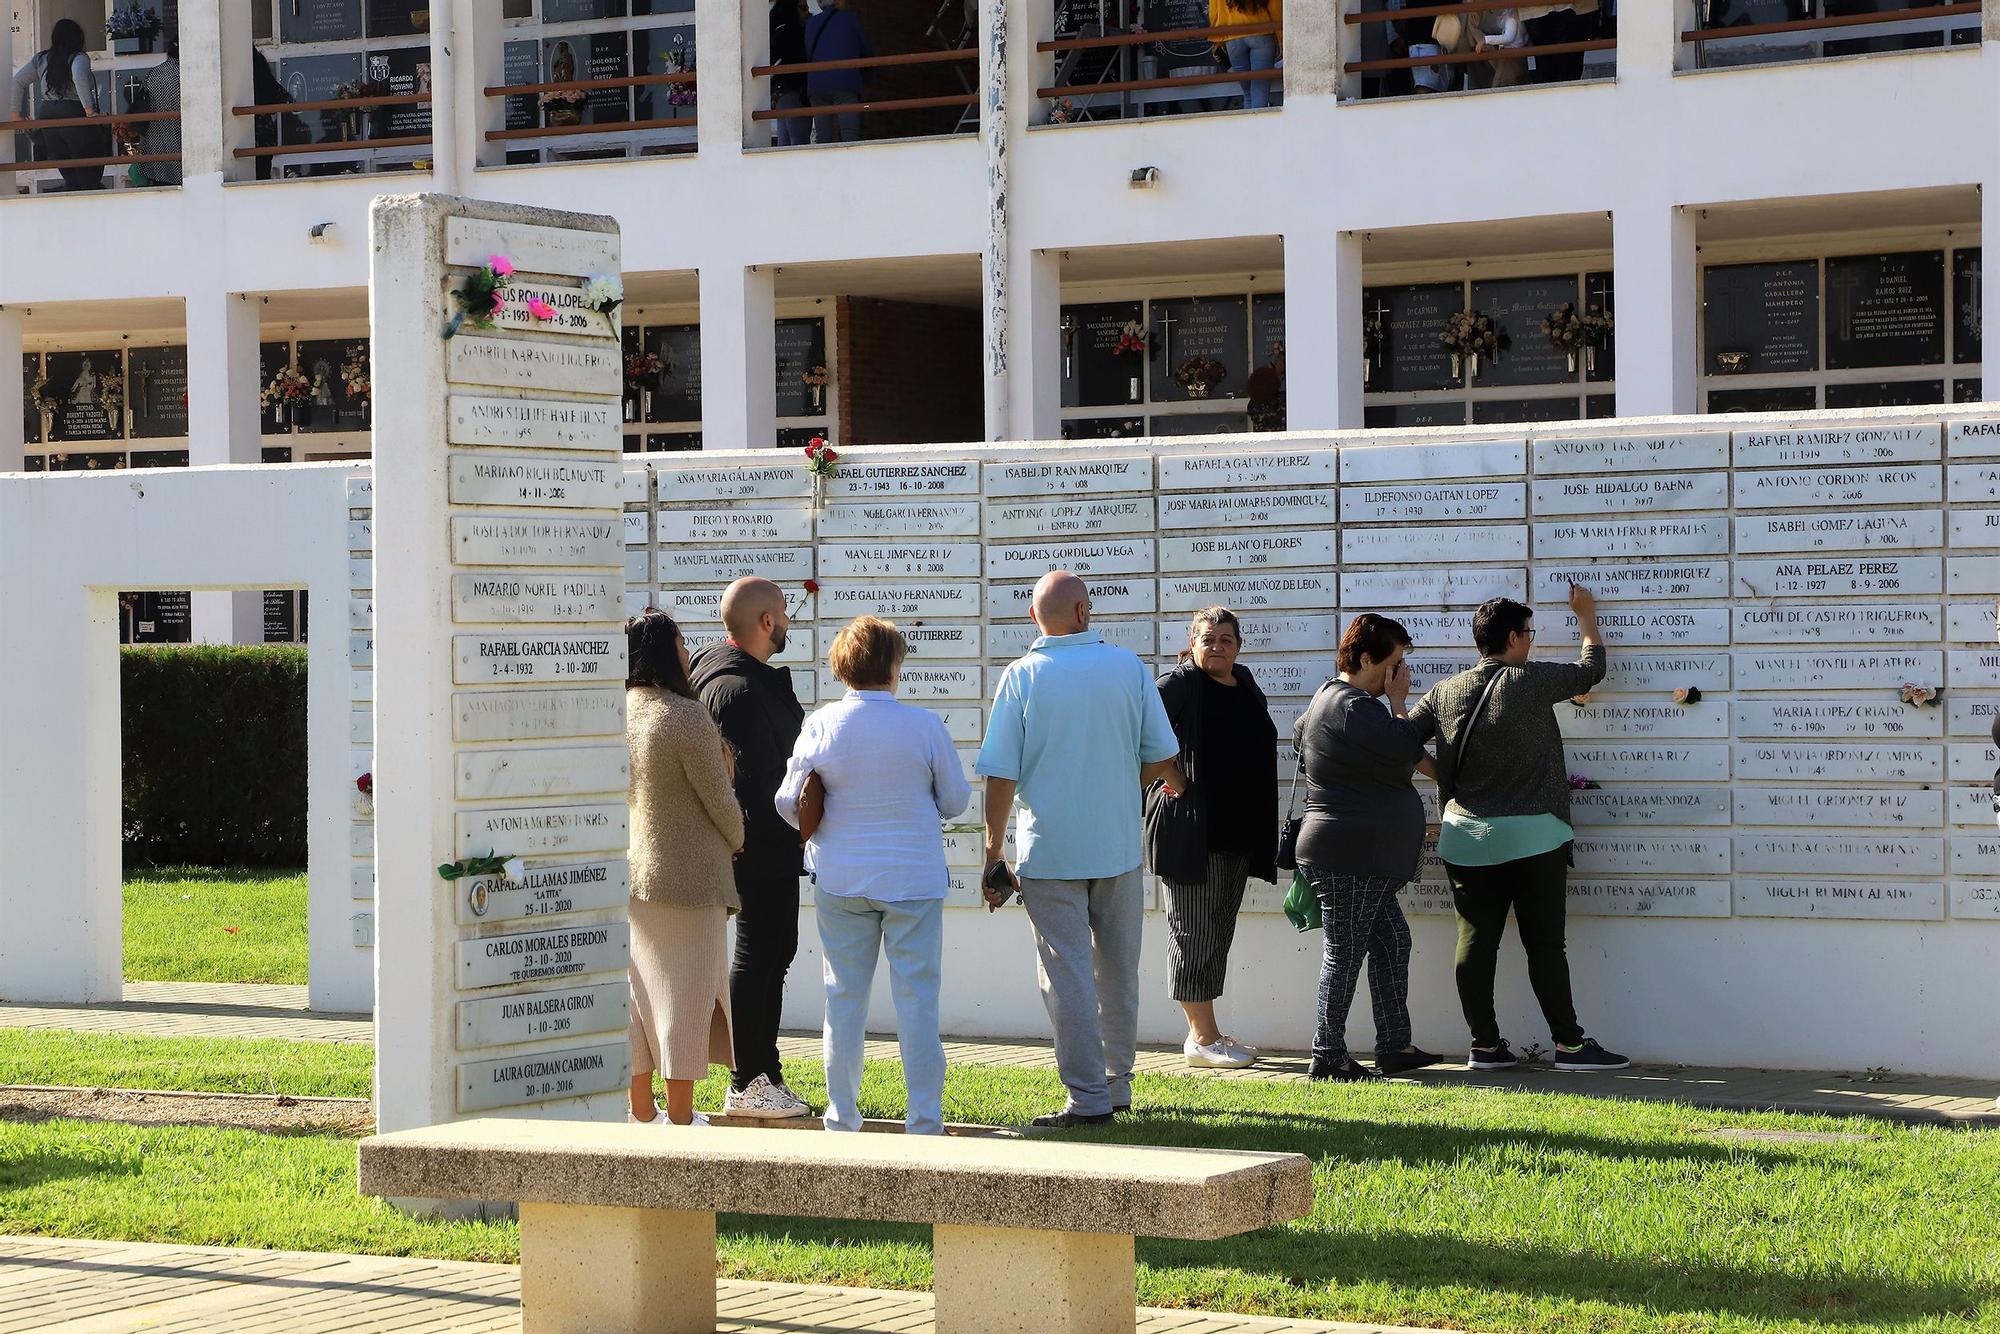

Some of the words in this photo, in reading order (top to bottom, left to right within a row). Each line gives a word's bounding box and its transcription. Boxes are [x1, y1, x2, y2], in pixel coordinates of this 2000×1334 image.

[592, 57, 620, 65] DOLORES
[587, 65, 619, 73] CARMONA
[1886, 276, 1907, 284] DANIEL
[1414, 307, 1438, 315] CARMEN
[1391, 321, 1420, 329] GONZALEZ
[1749, 435, 1794, 447] RAFAEL
[1797, 432, 1851, 445] RAMIREZ
[1184, 458, 1230, 471] RAFAELA
[1277, 456, 1310, 467] PEREZ
[729, 471, 761, 482] GALAN
[763, 470, 794, 480] PAVON
[866, 467, 919, 478] GUTIERREZ
[921, 466, 966, 477] SANCHEZ
[1005, 467, 1040, 478] ISABEL
[1079, 463, 1129, 475] MARQUEZ
[1817, 473, 1869, 485] CORDON
[1877, 472, 1917, 483] ARCOS
[1563, 484, 1589, 495] JOSE
[1595, 482, 1648, 493] HIDALGO
[1654, 480, 1693, 491] BAENA
[1364, 492, 1421, 503] ILDEFONSO
[1424, 490, 1464, 501] GAITAN
[1466, 489, 1499, 500] LOPEZ
[1167, 500, 1186, 511] JOSE
[1188, 500, 1217, 510] MARIA
[1219, 498, 1271, 509] PALOMARES
[1272, 495, 1327, 506] DOMINGUEZ
[1002, 508, 1047, 520] ANTONIO
[1051, 506, 1082, 518] LOPEZ
[1088, 503, 1138, 516] MARQUEZ
[693, 515, 722, 525] DIEGO
[724, 515, 731, 524] Y
[732, 514, 773, 525] ROSARIO
[1768, 522, 1807, 532] ISABEL
[1811, 519, 1853, 531] GOMEZ
[1554, 527, 1576, 539] JOSE
[1580, 526, 1615, 538] MARIA
[1660, 524, 1707, 535] PERALES
[1192, 542, 1215, 552] JOSE
[1218, 540, 1260, 551] BLANCO
[1263, 538, 1302, 549] FLORES
[674, 554, 709, 565] MANUEL
[756, 552, 795, 563] SANCHEZ
[845, 550, 885, 560] MANUEL
[887, 550, 927, 559] JIMENEZ
[1005, 549, 1050, 561] DOLORES
[1052, 547, 1104, 559] GORDILLO
[1106, 546, 1134, 557] VEGA
[1605, 569, 1650, 581] SANCHEZ
[1653, 567, 1711, 579] RODRIGUEZ
[1776, 565, 1801, 576] ANA
[1807, 563, 1853, 575] PELAEZ
[1859, 562, 1898, 574] PEREZ
[474, 582, 520, 596] NAZARIO
[1175, 583, 1211, 593] MANUEL
[1213, 580, 1246, 592] MUÑOZ
[1248, 579, 1280, 591] MUÑOZ
[1283, 580, 1296, 590] DE
[1297, 579, 1321, 590] LEON
[676, 595, 718, 606] DOLORES
[834, 591, 856, 601] JOSE
[858, 591, 901, 600] GALIANO
[904, 589, 962, 600] FERNANDEZ
[1596, 615, 1645, 627] DURILLO
[1651, 615, 1695, 626] ACOSTA
[908, 630, 962, 641] GUTIERREZ
[480, 642, 520, 656] RAFAEL
[522, 642, 561, 656] GARCIA
[563, 641, 609, 655] SANCHEZ
[924, 671, 965, 683] BARRANCO
[1574, 708, 1599, 719] JOSE
[1603, 708, 1630, 719] DIAZ
[1633, 708, 1685, 718] NOTARIO
[1772, 707, 1812, 717] MARIA
[1620, 795, 1649, 806] LARA
[1651, 795, 1701, 806] MENDOZA
[530, 872, 568, 889] LLAMAS
[569, 866, 607, 885] JIMÉNEZ
[1567, 885, 1602, 896] PABLO
[1606, 885, 1634, 896] TENA
[1637, 886, 1696, 897] SALVADOR
[486, 941, 524, 958] CARLOS
[525, 935, 570, 954] MORALES
[571, 930, 608, 948] BERDON
[522, 967, 555, 979] QUEREMOS
[502, 1002, 525, 1019] JUAN
[527, 999, 566, 1016] BALSERA
[567, 994, 594, 1009] GIRON
[494, 1066, 523, 1083] LAURA
[523, 1061, 561, 1078] GUZMAN
[562, 1055, 604, 1073] CARMONA
